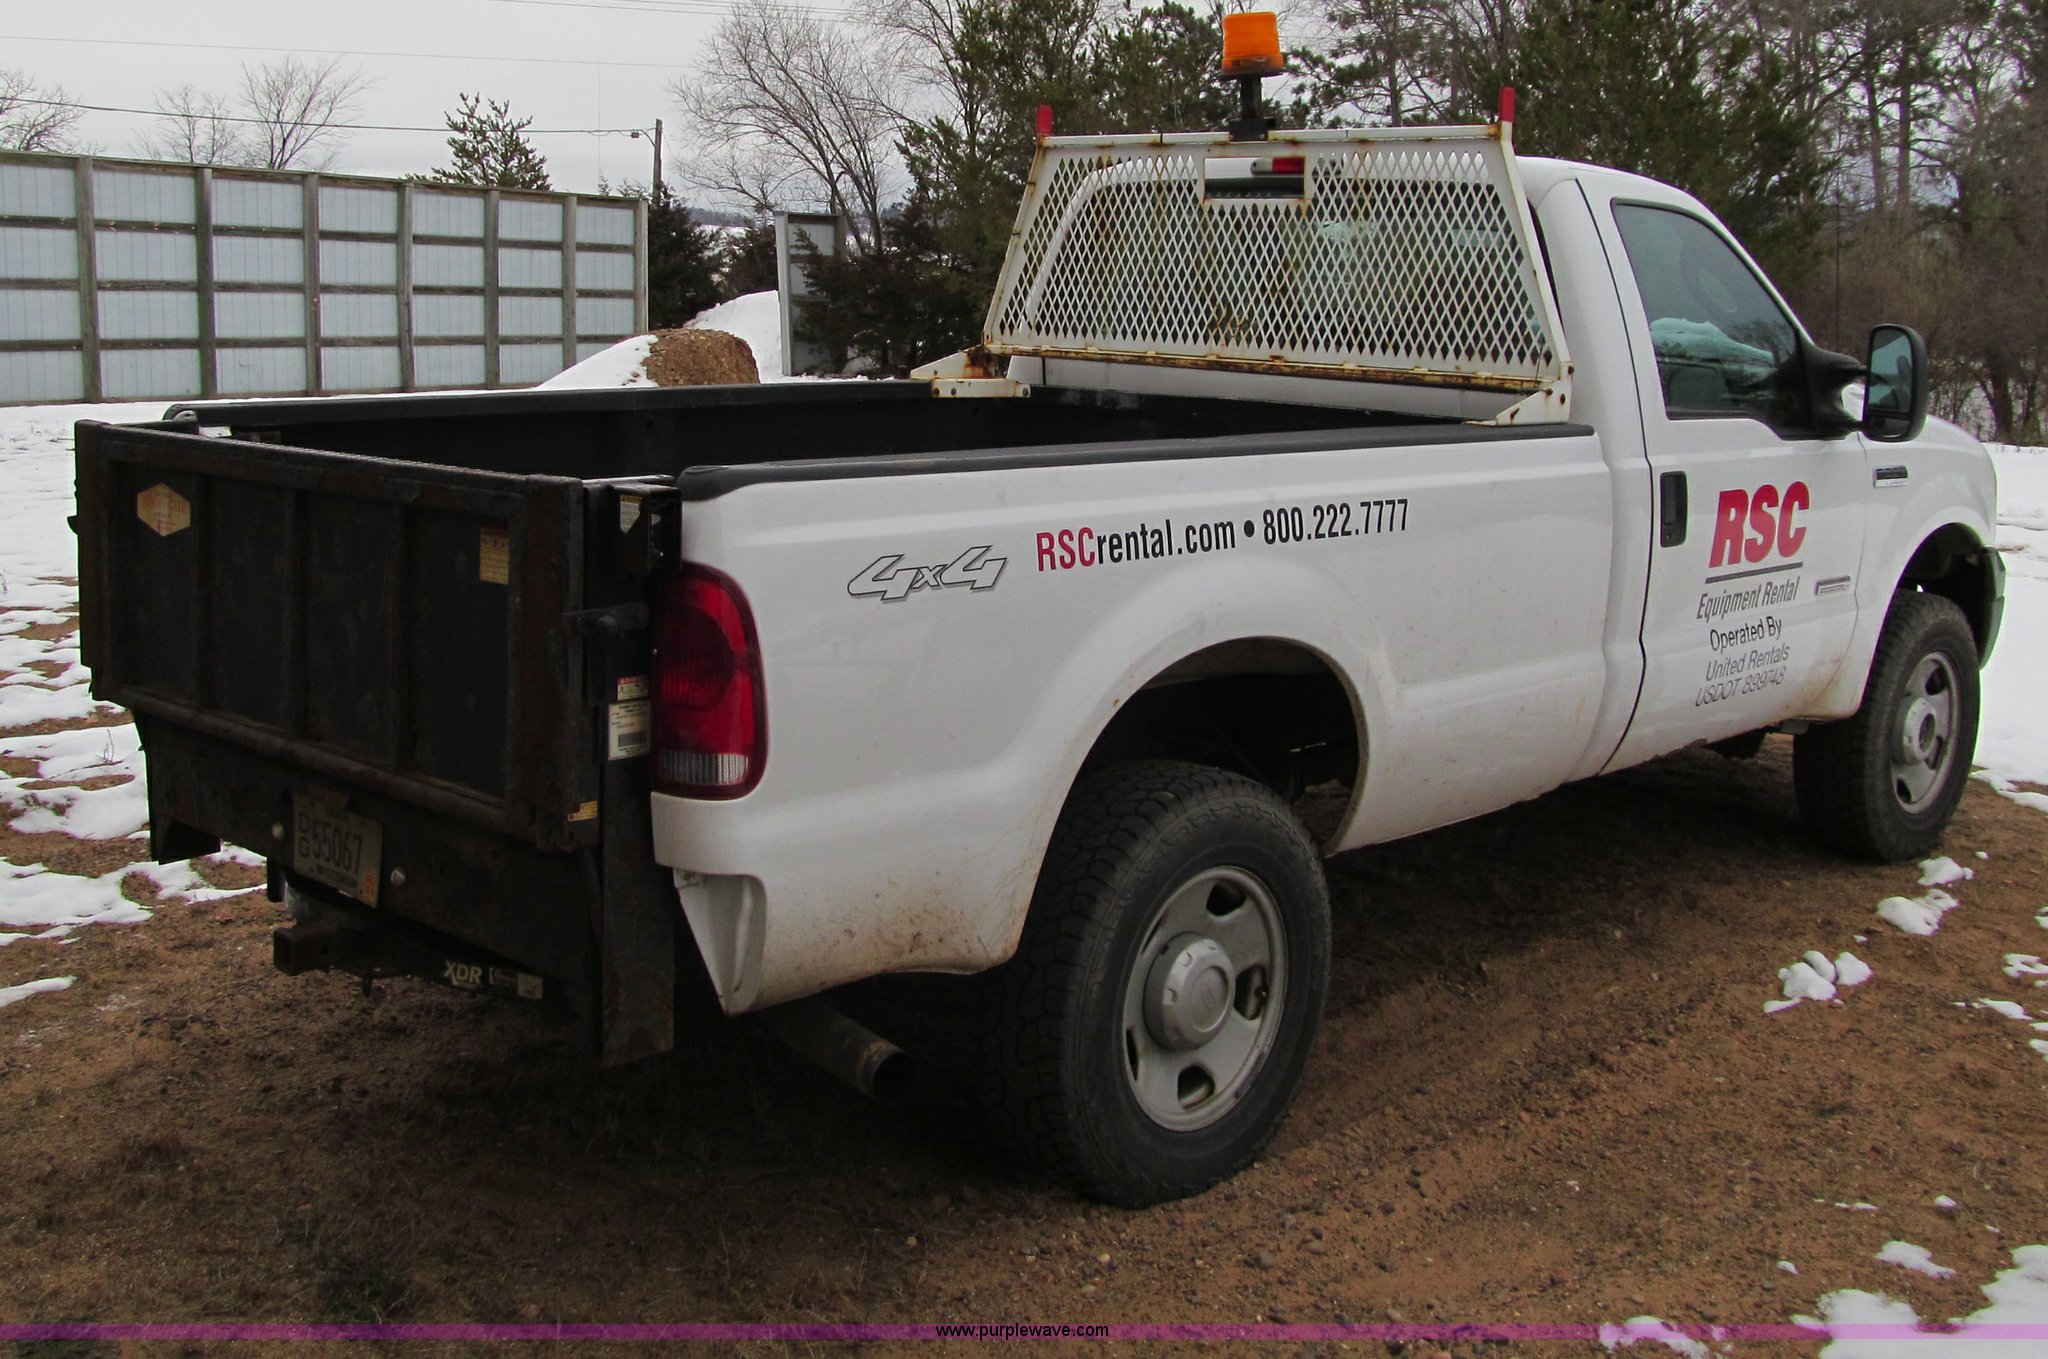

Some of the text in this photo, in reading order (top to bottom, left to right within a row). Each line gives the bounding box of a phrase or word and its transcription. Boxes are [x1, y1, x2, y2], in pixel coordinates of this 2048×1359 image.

[1036, 498, 1408, 572] RSCrental.com 800.222.7777
[1709, 481, 1810, 568] RSC
[848, 545, 1008, 603] 4x4
[1696, 576, 1800, 623] Equipment Rental
[1709, 615, 1782, 654] Operated By
[1705, 642, 1790, 681] United Rentals
[1695, 678, 1742, 707] USDOT
